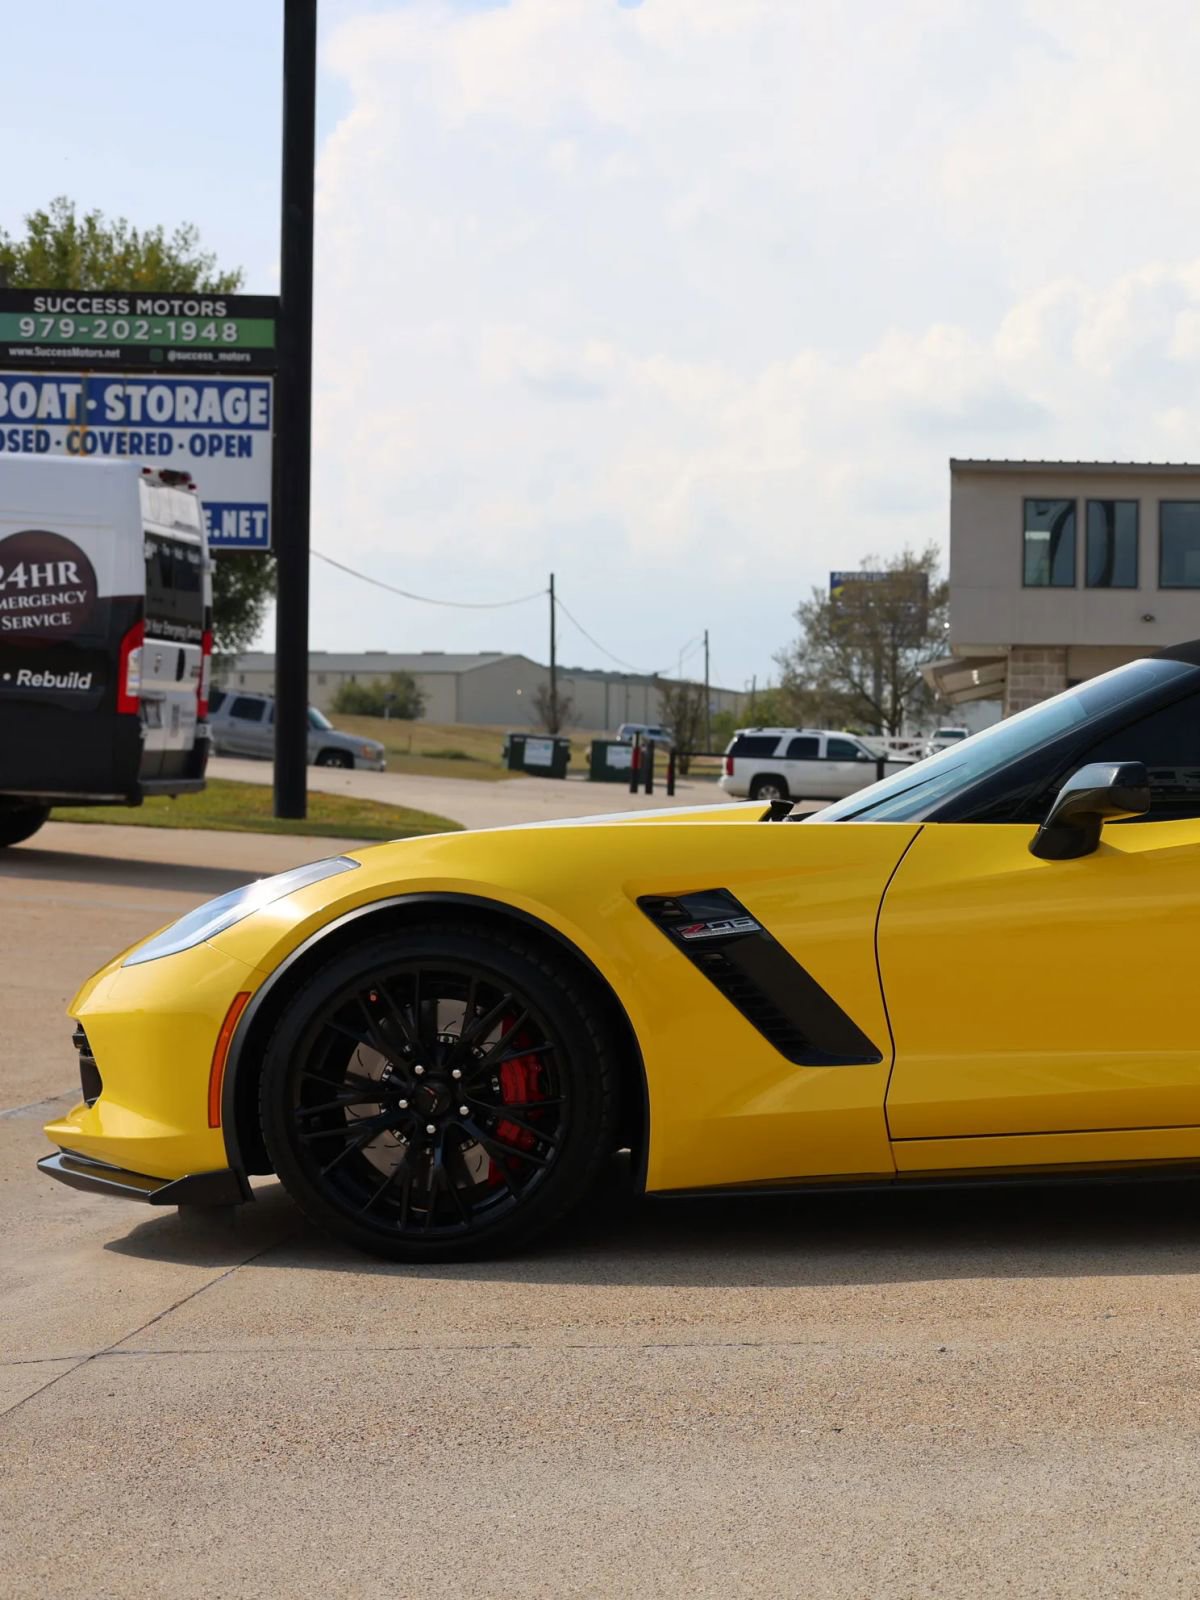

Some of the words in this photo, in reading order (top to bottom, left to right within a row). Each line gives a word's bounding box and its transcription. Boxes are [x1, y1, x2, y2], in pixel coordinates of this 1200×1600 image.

[33, 297, 130, 314] SUCCESS
[136, 299, 227, 317] MOTORS
[19, 317, 238, 342] 979-202-1948
[8, 346, 121, 359] www.SuccessMotors.net
[104, 384, 268, 425] STORAGE
[66, 430, 173, 457] COVERED
[189, 433, 253, 458] OPEN
[1, 611, 72, 631] SERVICE
[16, 669, 93, 689] Rebuild
